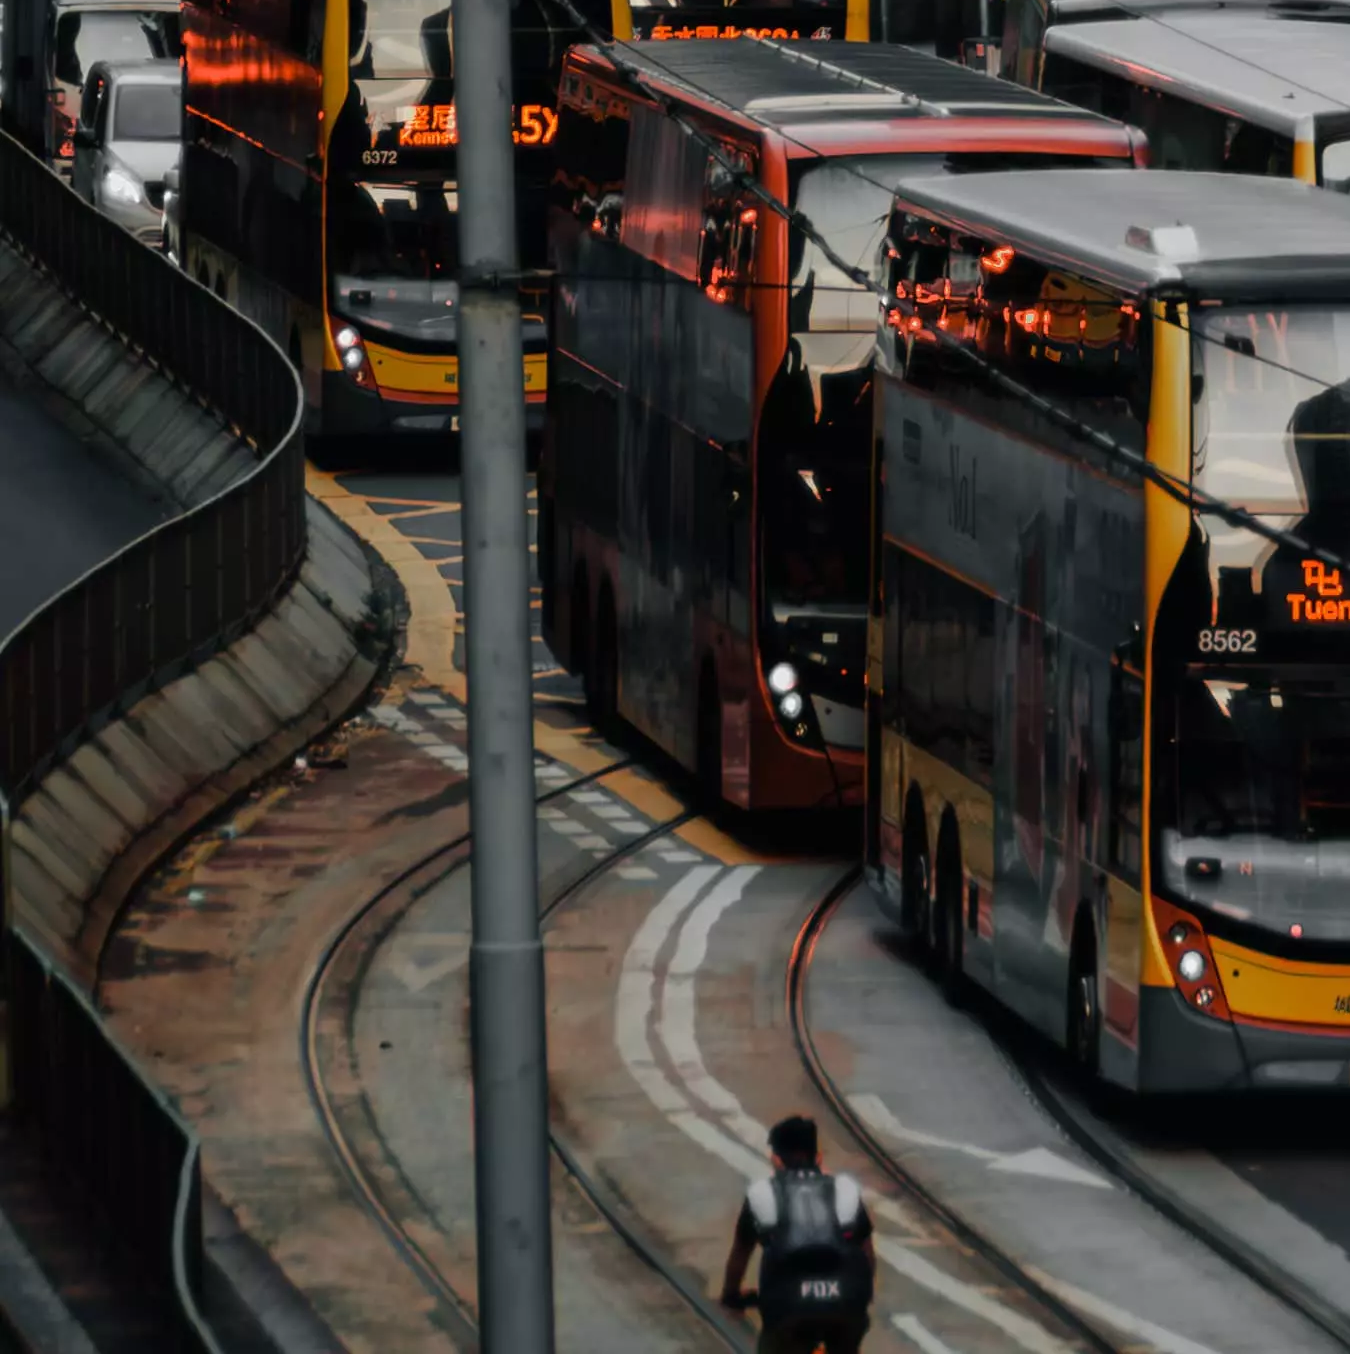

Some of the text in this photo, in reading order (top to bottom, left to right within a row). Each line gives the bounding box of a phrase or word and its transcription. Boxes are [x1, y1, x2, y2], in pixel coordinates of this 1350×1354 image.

[362, 150, 398, 164] 6372
[1198, 629, 1257, 653] 8562
[801, 1280, 840, 1299] FOX
